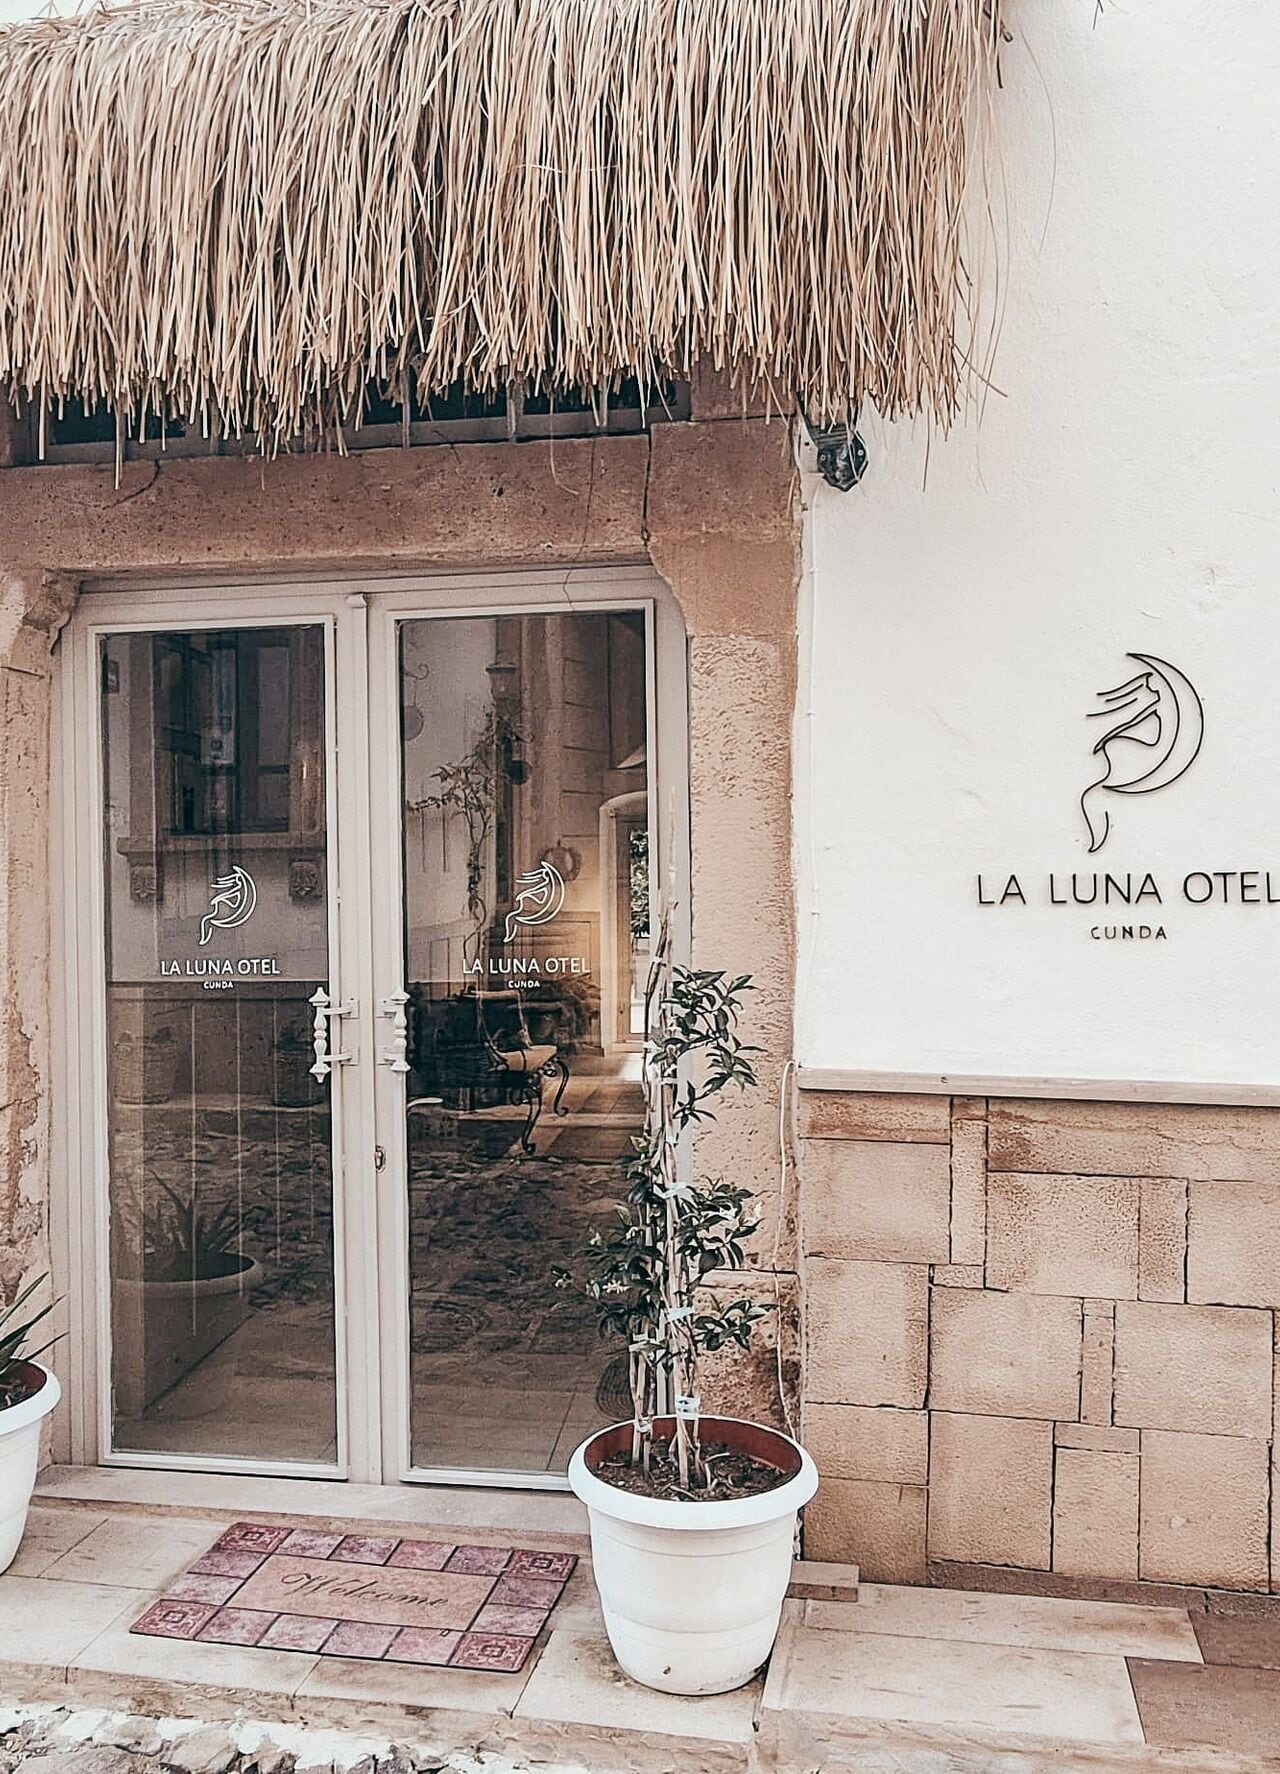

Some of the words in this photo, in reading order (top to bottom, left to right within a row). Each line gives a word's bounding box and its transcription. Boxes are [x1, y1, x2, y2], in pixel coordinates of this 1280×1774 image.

[977, 873, 1026, 905] LA
[1049, 872, 1163, 905] LUNA
[1090, 925, 1167, 940] CUNDA
[161, 960, 181, 975] LA
[186, 960, 234, 975] LUNA
[237, 959, 280, 975] OTEL
[462, 958, 484, 973] LA
[489, 958, 540, 973] LUNA
[545, 958, 591, 973] OTEL
[203, 981, 234, 989] CUNDA
[508, 980, 540, 988] CUNDA
[280, 1572, 449, 1607] Welcome
